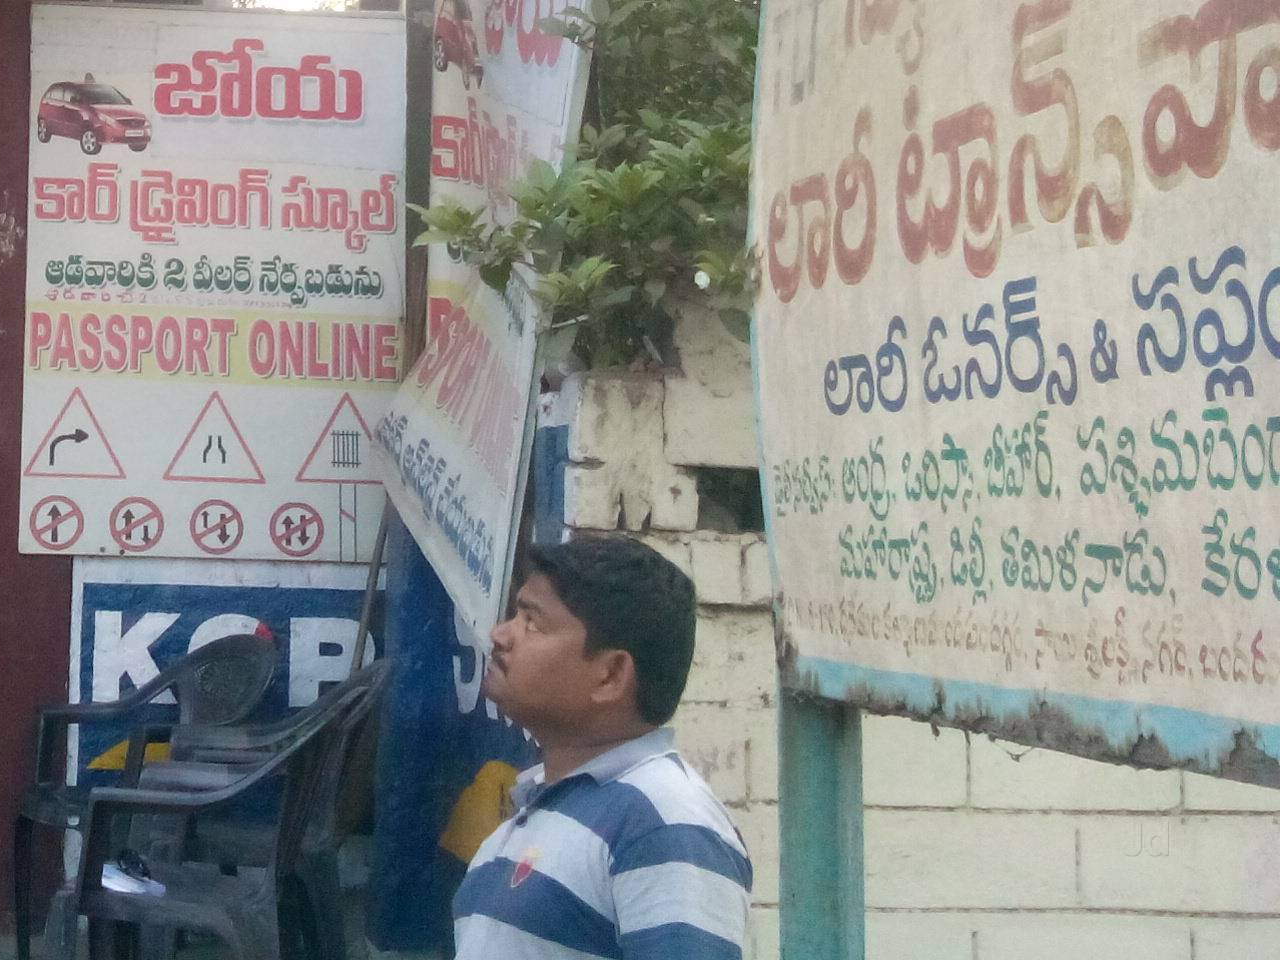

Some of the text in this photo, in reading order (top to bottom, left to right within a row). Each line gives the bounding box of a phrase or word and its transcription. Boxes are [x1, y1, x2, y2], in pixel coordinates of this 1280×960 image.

[153, 38, 365, 124] జోయ
[33, 163, 399, 254] కార్ డ్రైవింగ్ స్కూల్
[44, 251, 157, 289] ఆడవారికి
[163, 257, 188, 290] 2
[192, 255, 254, 292] వీలర్
[28, 310, 402, 383] PASSPORT ONLINE
[824, 315, 908, 416] లారీ
[1090, 318, 1120, 384] &
